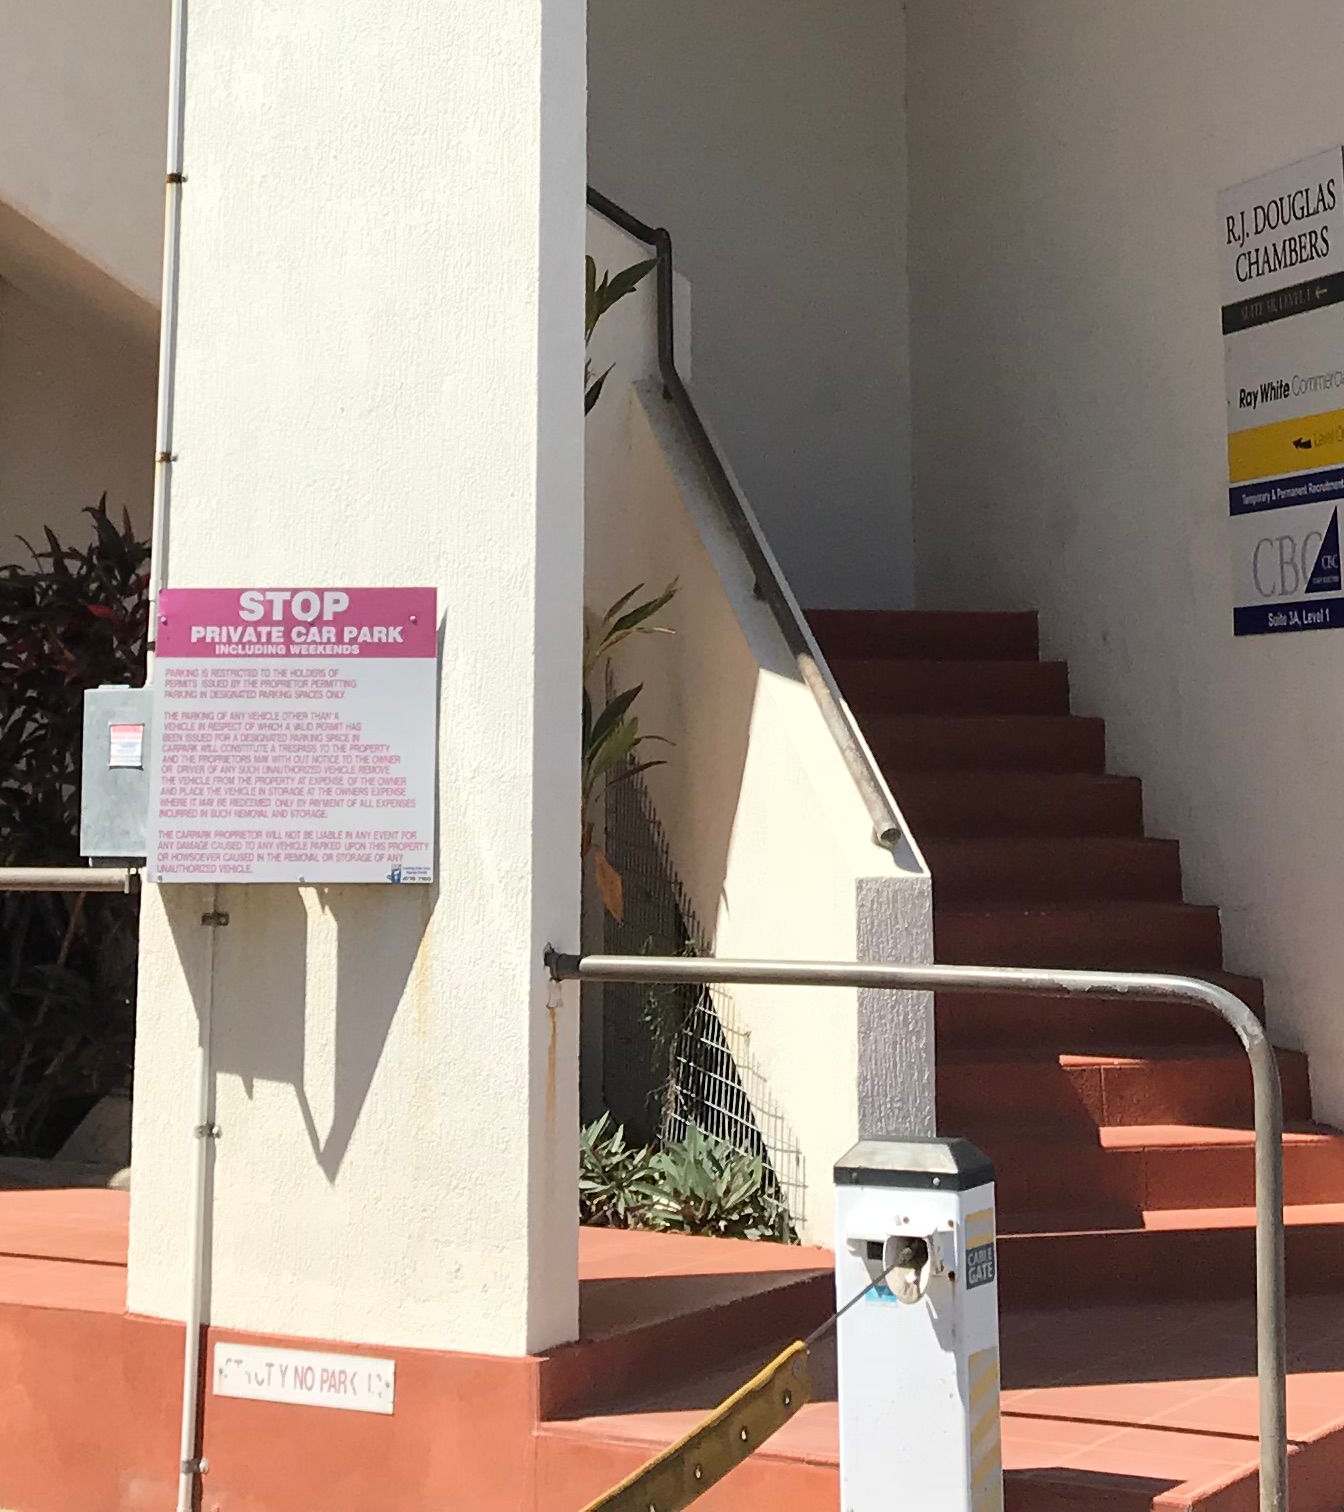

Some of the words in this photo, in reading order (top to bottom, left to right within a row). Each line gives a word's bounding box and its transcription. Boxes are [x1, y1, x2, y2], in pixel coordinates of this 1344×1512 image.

[1226, 211, 1250, 248] R.J.
[1253, 179, 1336, 235] DOUGLAS
[1235, 226, 1330, 282] CHAMBERS
[1239, 389, 1258, 409] Ray
[1260, 379, 1290, 403] White
[1272, 489, 1276, 500] &
[238, 590, 349, 621] STOP
[1268, 612, 1287, 627] Suite
[1302, 609, 1323, 624] Level
[1326, 608, 1330, 622] 1
[191, 626, 284, 643] PRIVATE
[291, 626, 336, 643] CAR
[343, 626, 404, 643] PARK
[215, 644, 286, 654] INCLUDING
[290, 644, 359, 654] WEEKENDS
[968, 1247, 992, 1267] CABLE
[968, 1261, 993, 1284] GATE
[294, 1366, 315, 1392] NO
